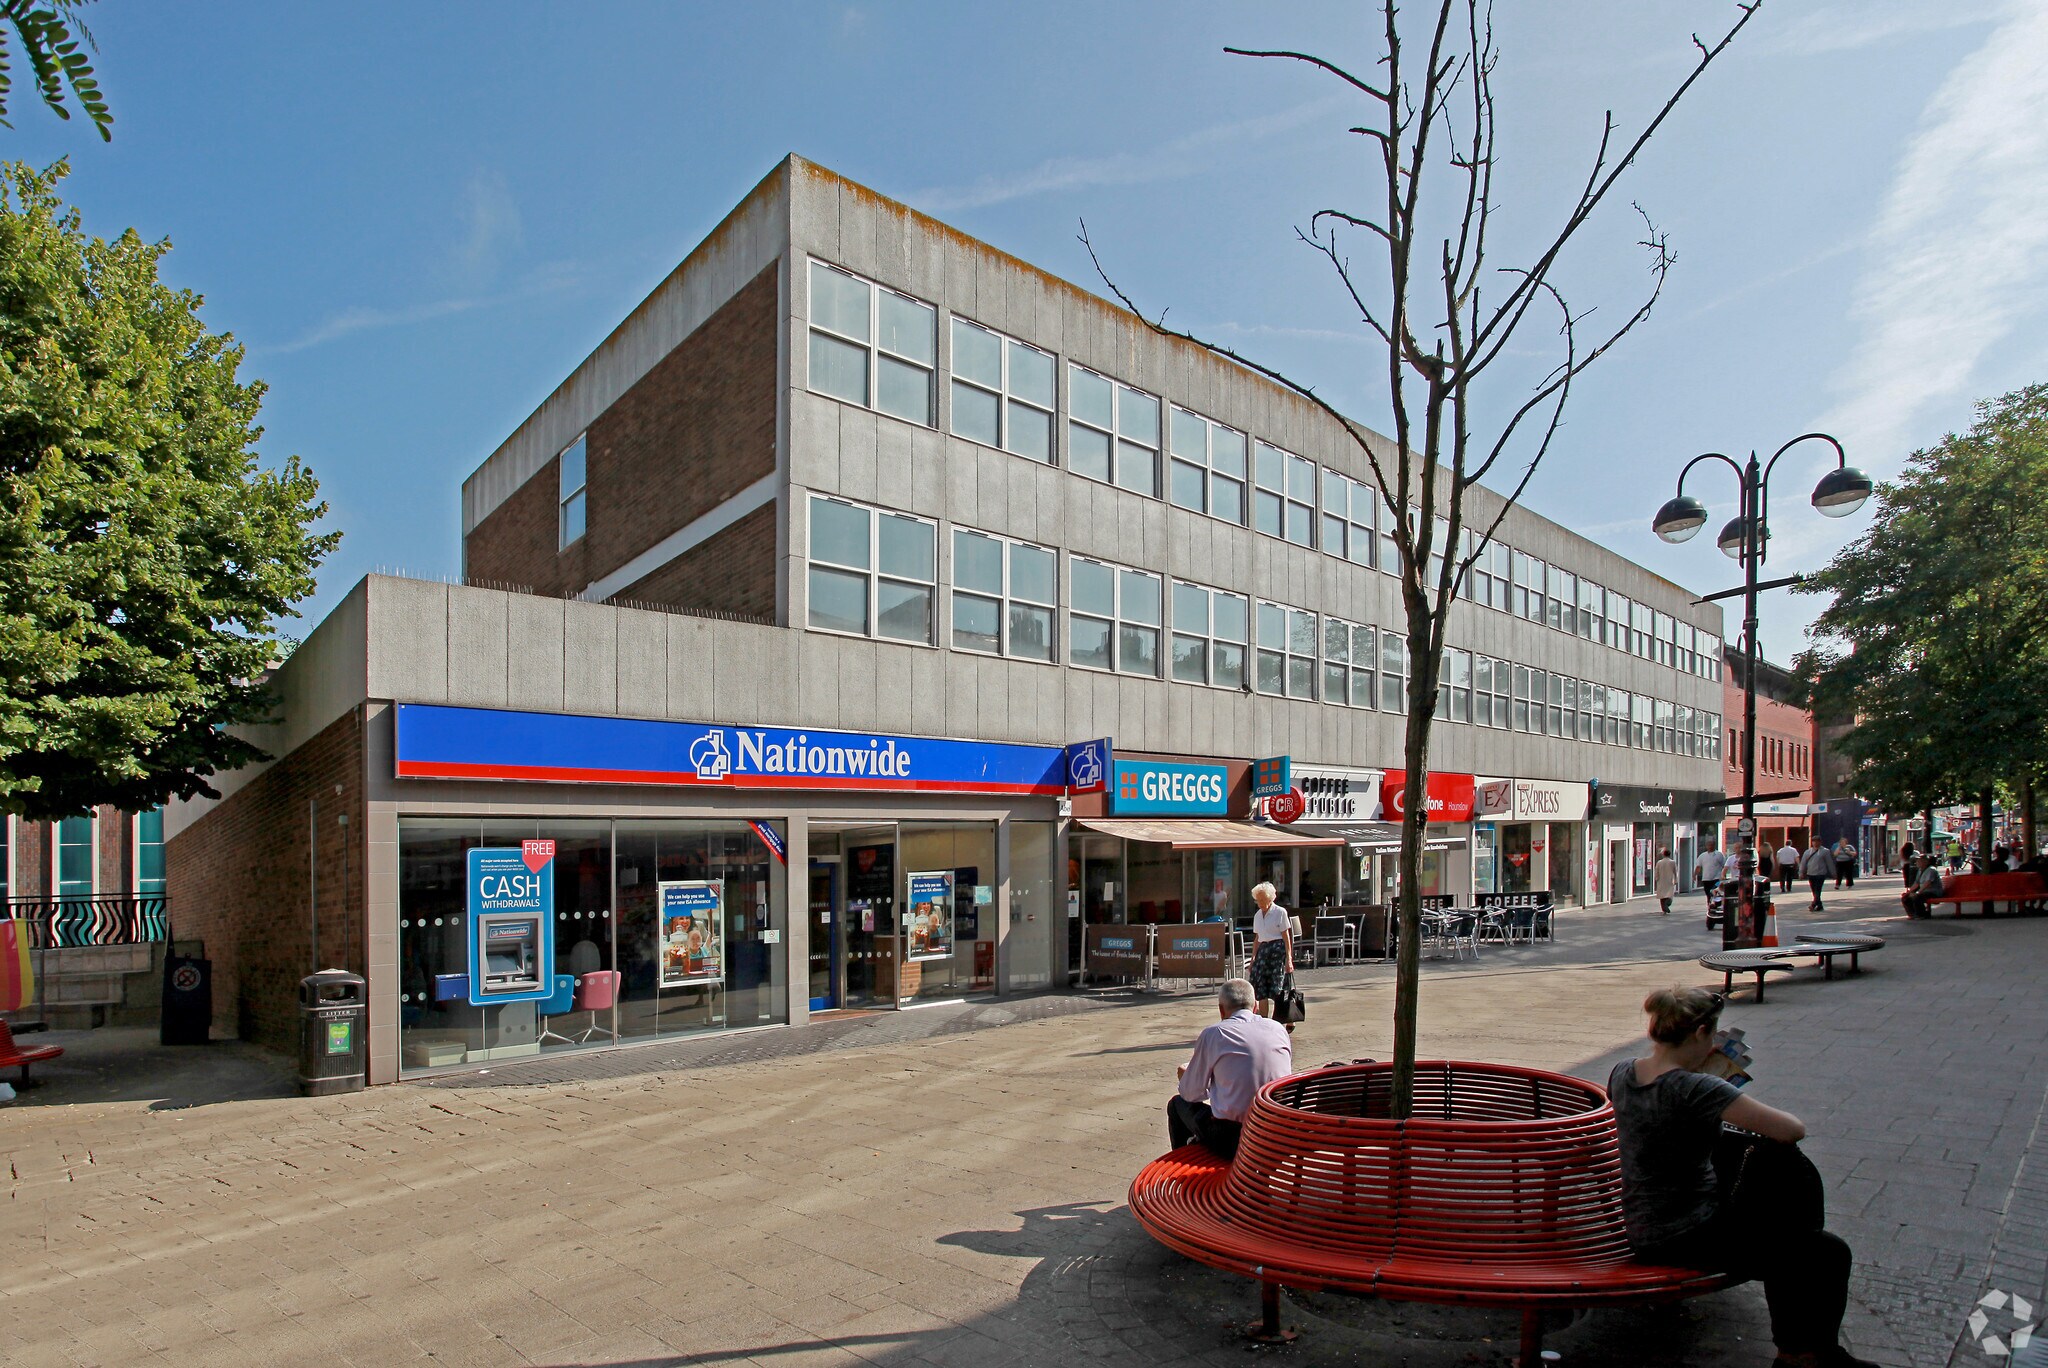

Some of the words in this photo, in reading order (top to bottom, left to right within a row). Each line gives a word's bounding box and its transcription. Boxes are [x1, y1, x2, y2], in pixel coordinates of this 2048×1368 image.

[735, 731, 911, 777] Nationwide
[1142, 771, 1222, 803] GREGGS
[1256, 784, 1283, 794] GREGGS
[1301, 776, 1349, 794] COFFEE
[1427, 796, 1443, 810] fone
[1448, 802, 1468, 810] Hounslow
[1484, 784, 1509, 808] EX
[1520, 784, 1560, 816] EXPRESS
[1276, 797, 1294, 812] CR
[1304, 797, 1356, 814] EPUBLIC
[1640, 800, 1670, 816] Superdrug
[524, 842, 553, 855] FREE
[480, 875, 540, 898] CASH
[482, 899, 540, 909] WITHDRAWALS
[1422, 898, 1444, 908] FEE
[1485, 895, 1538, 908] COFFEE
